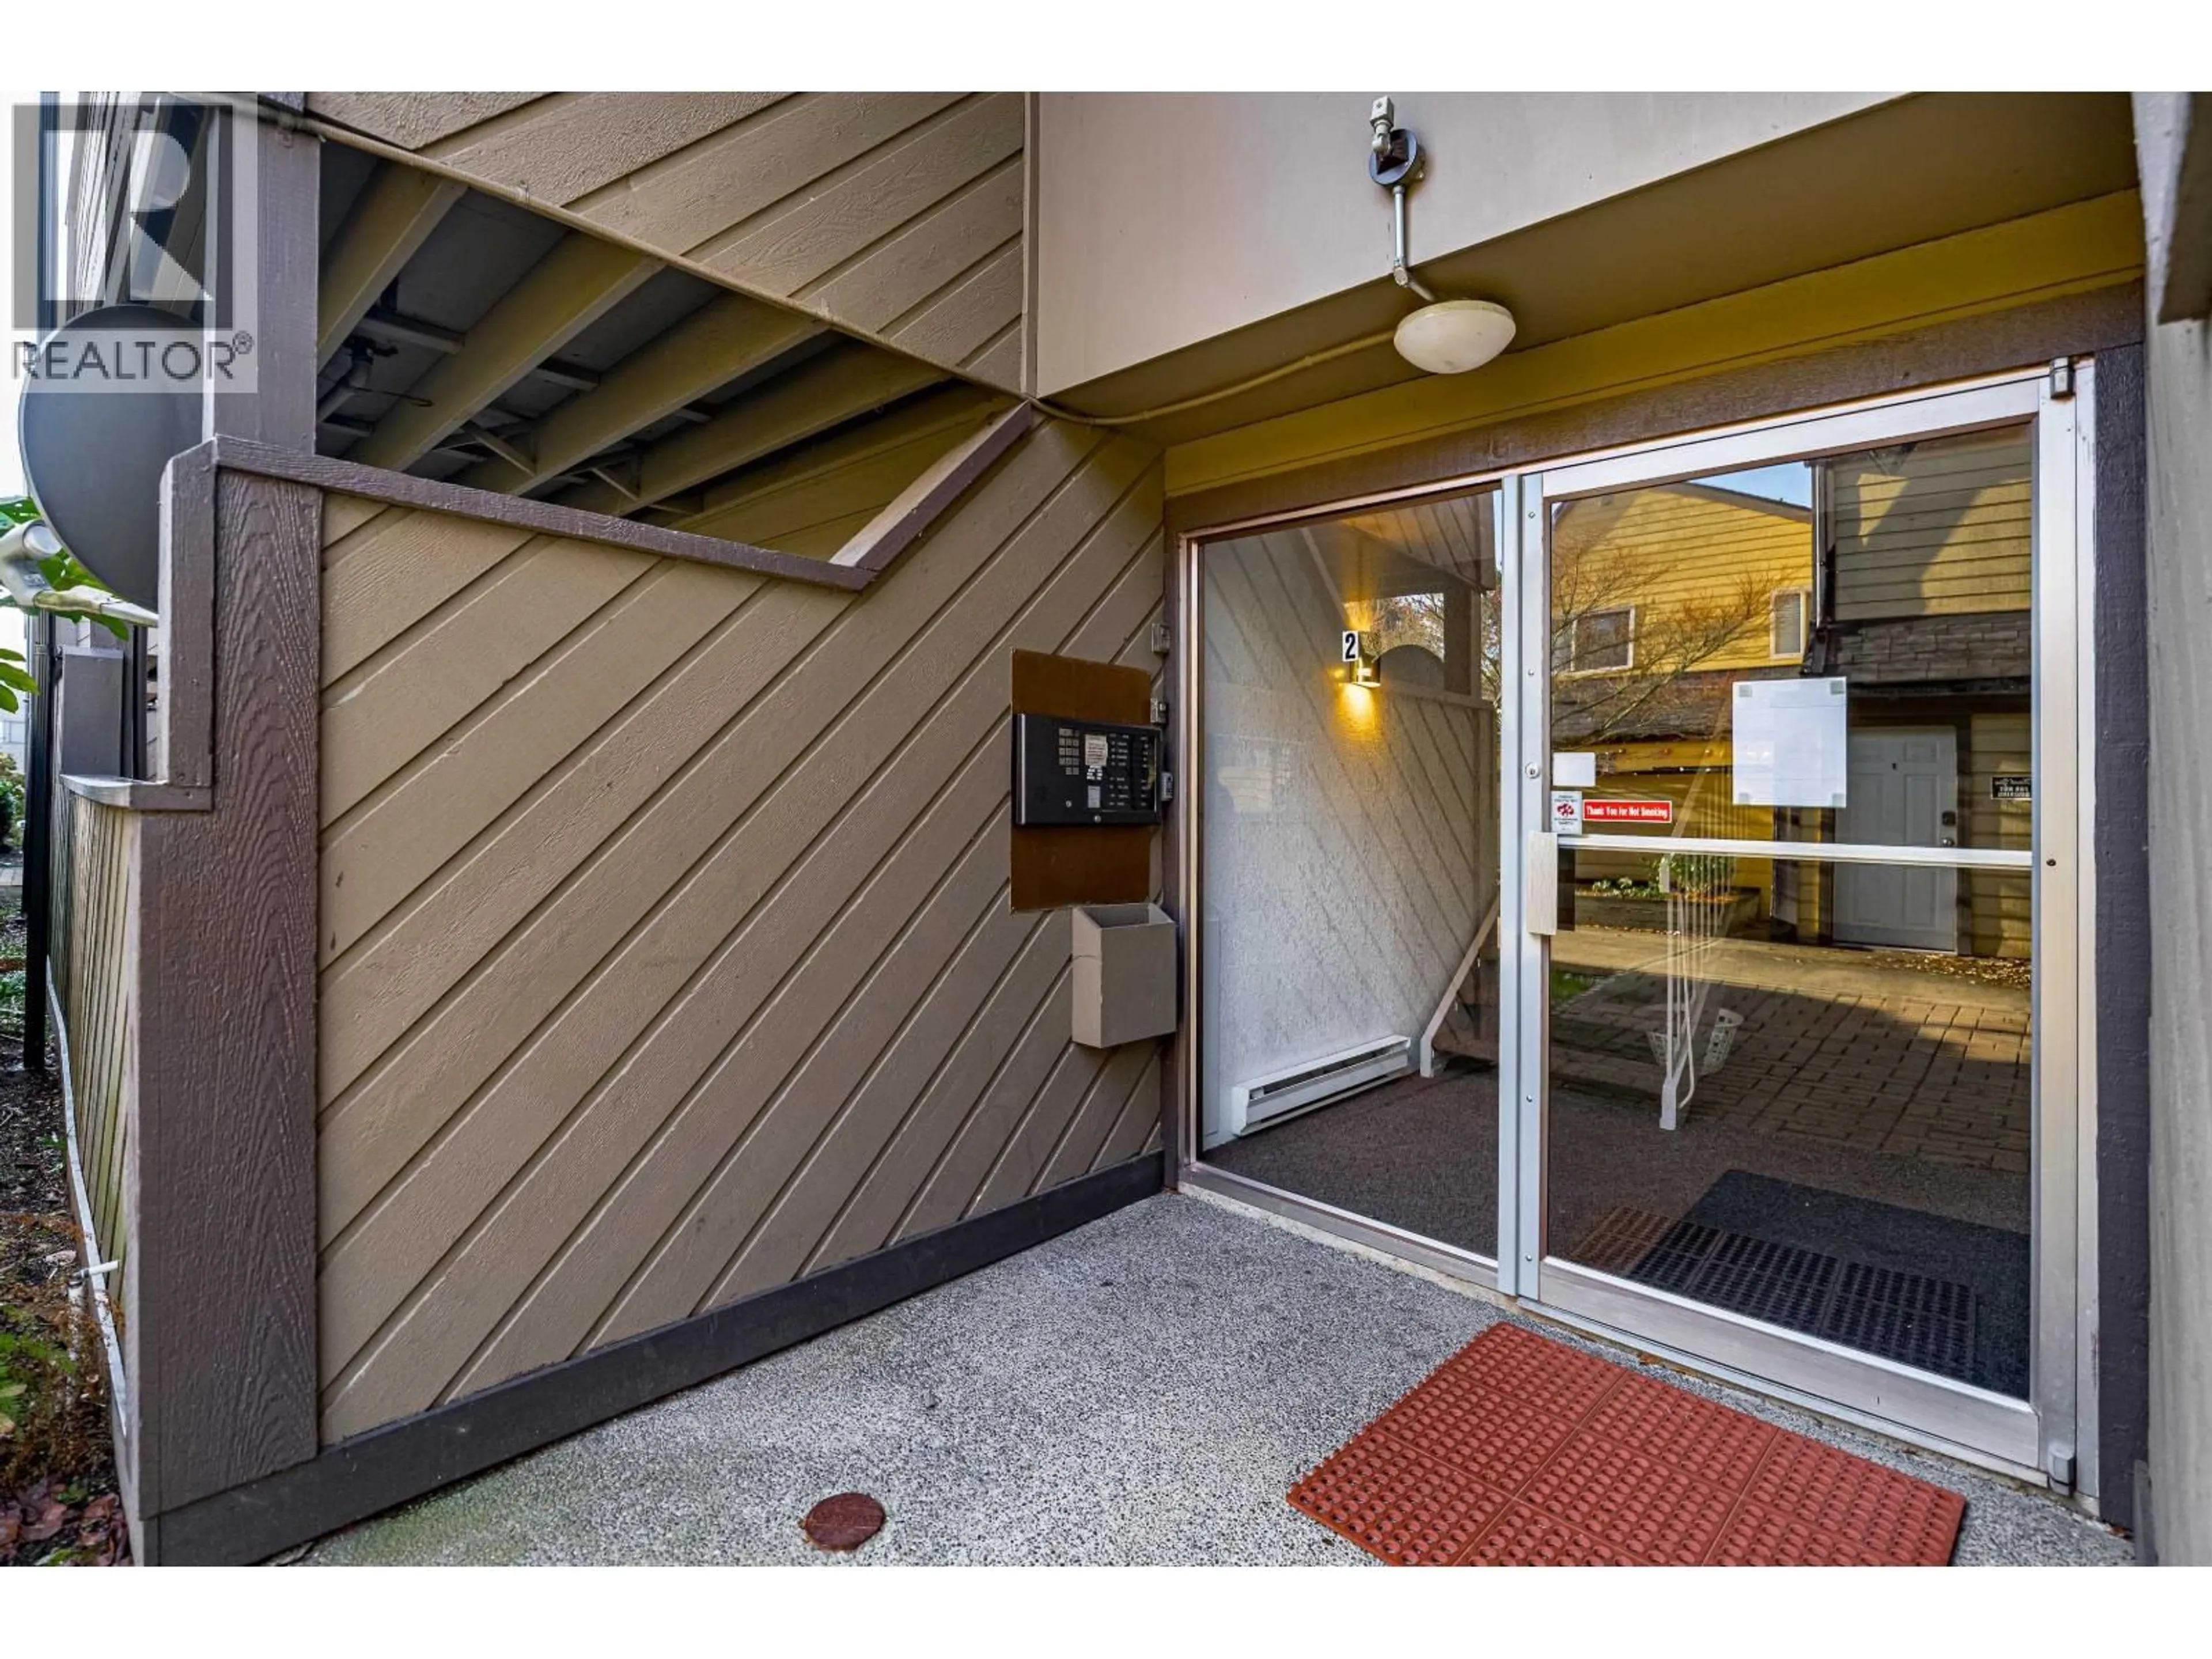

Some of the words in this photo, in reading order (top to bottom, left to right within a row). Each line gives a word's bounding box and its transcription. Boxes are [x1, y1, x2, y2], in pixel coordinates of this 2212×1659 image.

[1345, 633, 1355, 660] 2
[1586, 805, 1604, 815] Thank
[1606, 806, 1617, 816] You
[1619, 806, 1628, 816] for
[1628, 806, 1639, 816] Not
[1641, 806, 1668, 819] Smoking
